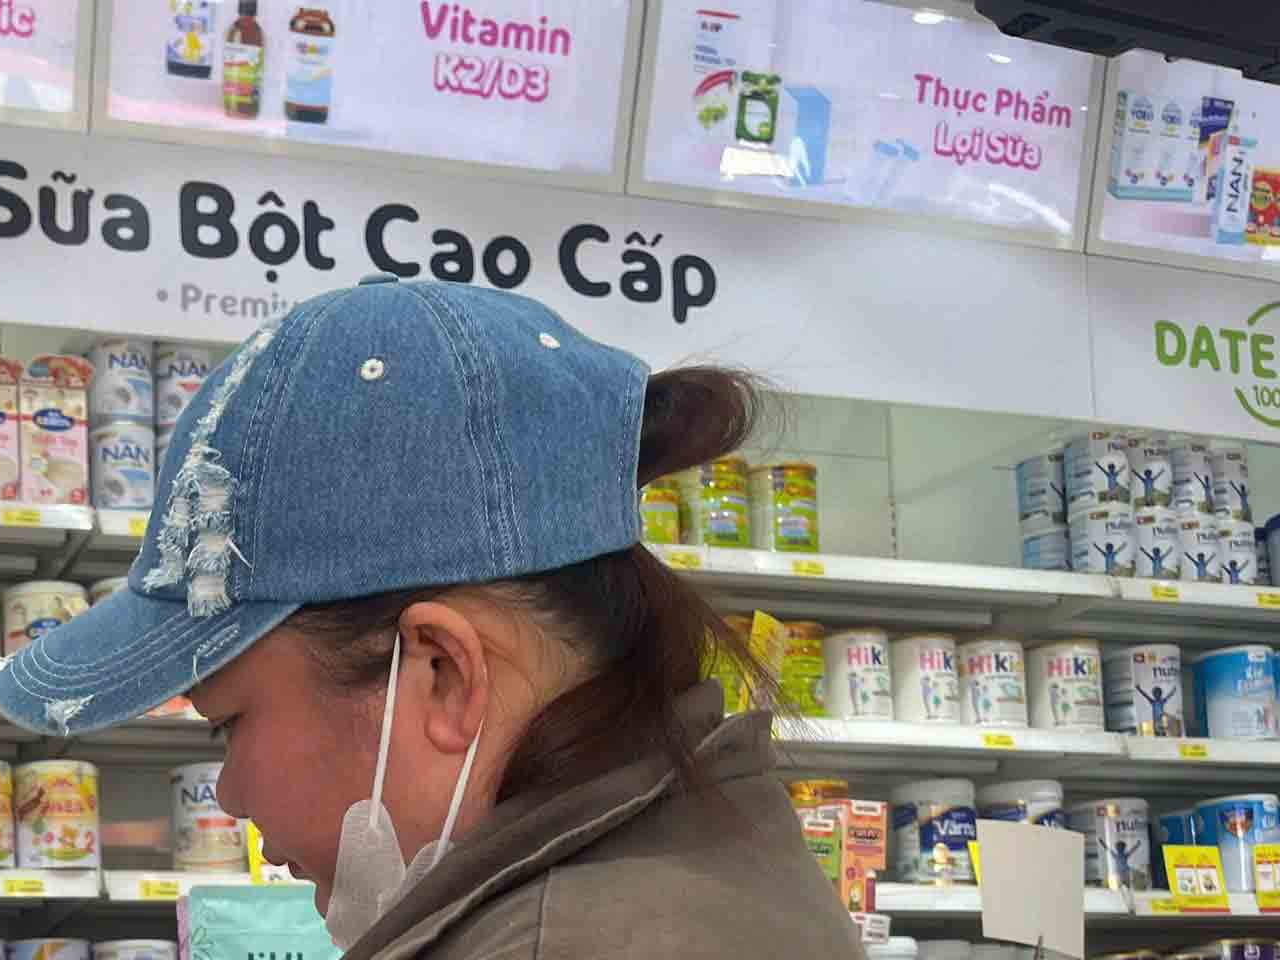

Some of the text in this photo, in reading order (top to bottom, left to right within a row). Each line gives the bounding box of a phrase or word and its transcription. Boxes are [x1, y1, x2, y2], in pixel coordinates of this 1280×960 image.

[421, 3, 572, 56] Vitamin
[432, 54, 550, 103] K2/D3
[914, 73, 1072, 130] Thực Phẩm
[179, 180, 335, 283] Bột
[364, 203, 531, 289] Cao
[558, 223, 717, 324] Cấp
[180, 284, 296, 320] Premi
[181, 785, 216, 806] NA
